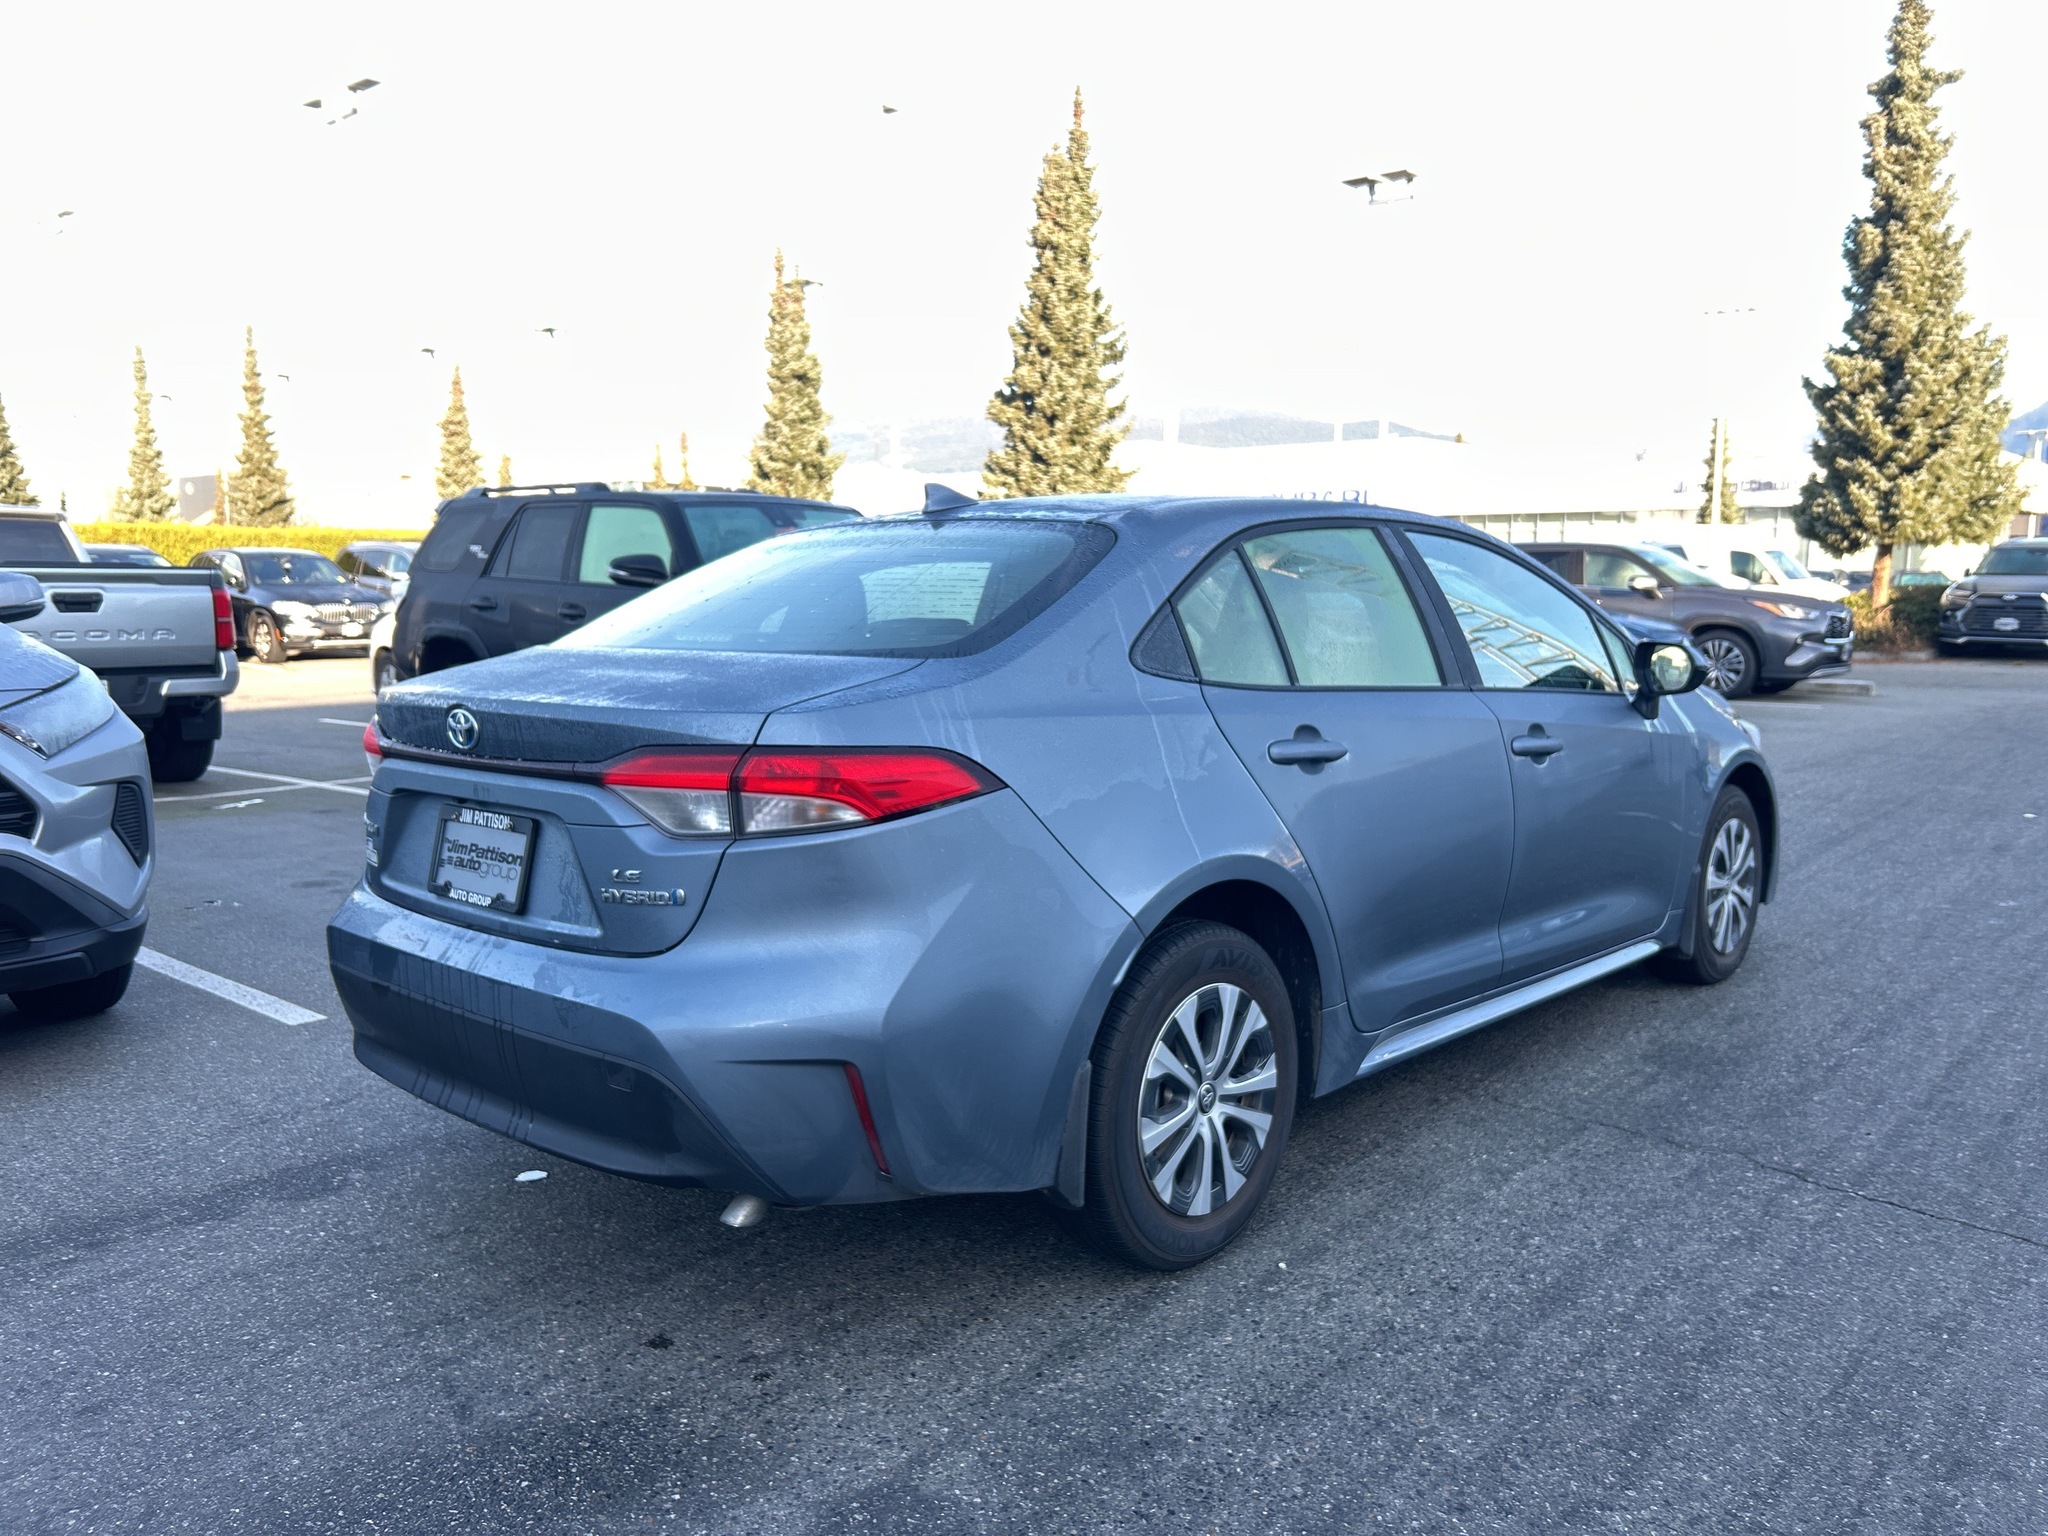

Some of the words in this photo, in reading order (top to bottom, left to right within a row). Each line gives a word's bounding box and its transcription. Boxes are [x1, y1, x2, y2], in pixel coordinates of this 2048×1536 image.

[460, 808, 473, 822] JIM
[474, 810, 510, 830] PATTISON
[612, 868, 642, 883] LE
[449, 888, 468, 902] AUTO
[468, 893, 493, 907] GROUP
[600, 888, 671, 905] HYBRID
